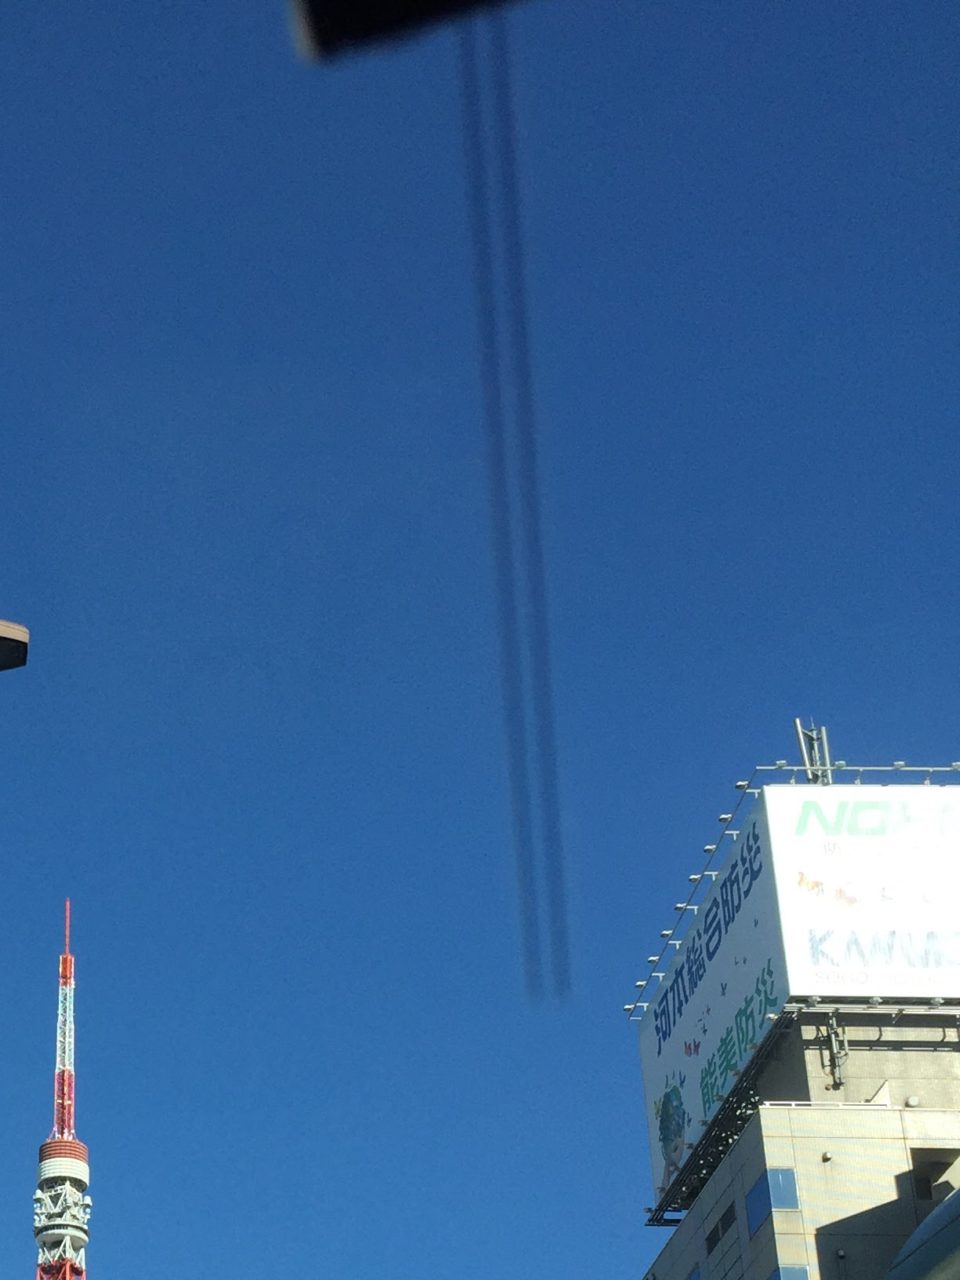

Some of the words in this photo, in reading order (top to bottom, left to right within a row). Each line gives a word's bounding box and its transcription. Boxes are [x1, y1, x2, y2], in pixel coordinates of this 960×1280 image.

[653, 821, 763, 1057] 河本総合防災
[699, 957, 778, 1119] 能美防災
